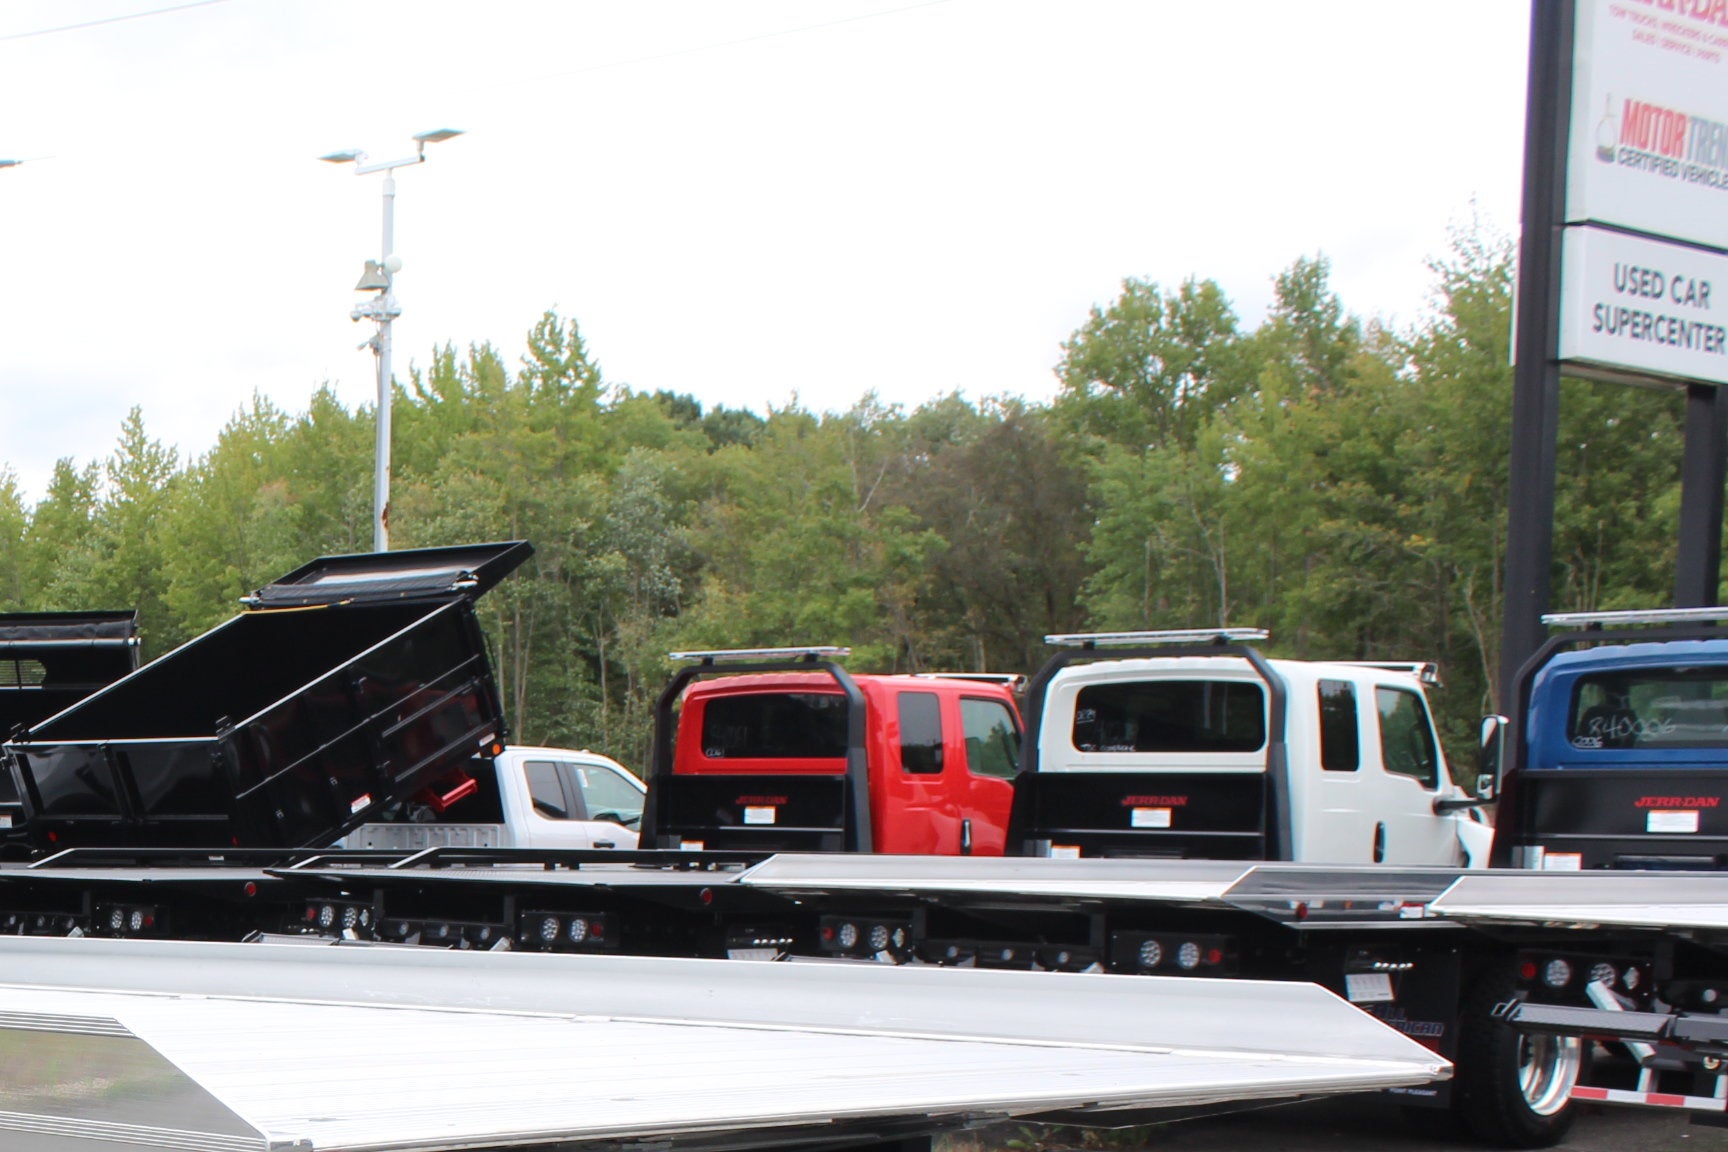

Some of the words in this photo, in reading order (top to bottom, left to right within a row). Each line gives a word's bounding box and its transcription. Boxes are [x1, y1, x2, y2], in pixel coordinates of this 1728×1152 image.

[1618, 146, 1680, 178] CERTIFIED
[1613, 262, 1666, 300] USED
[1670, 274, 1712, 310] CAR
[1591, 302, 1727, 356] SUPERCENTER
